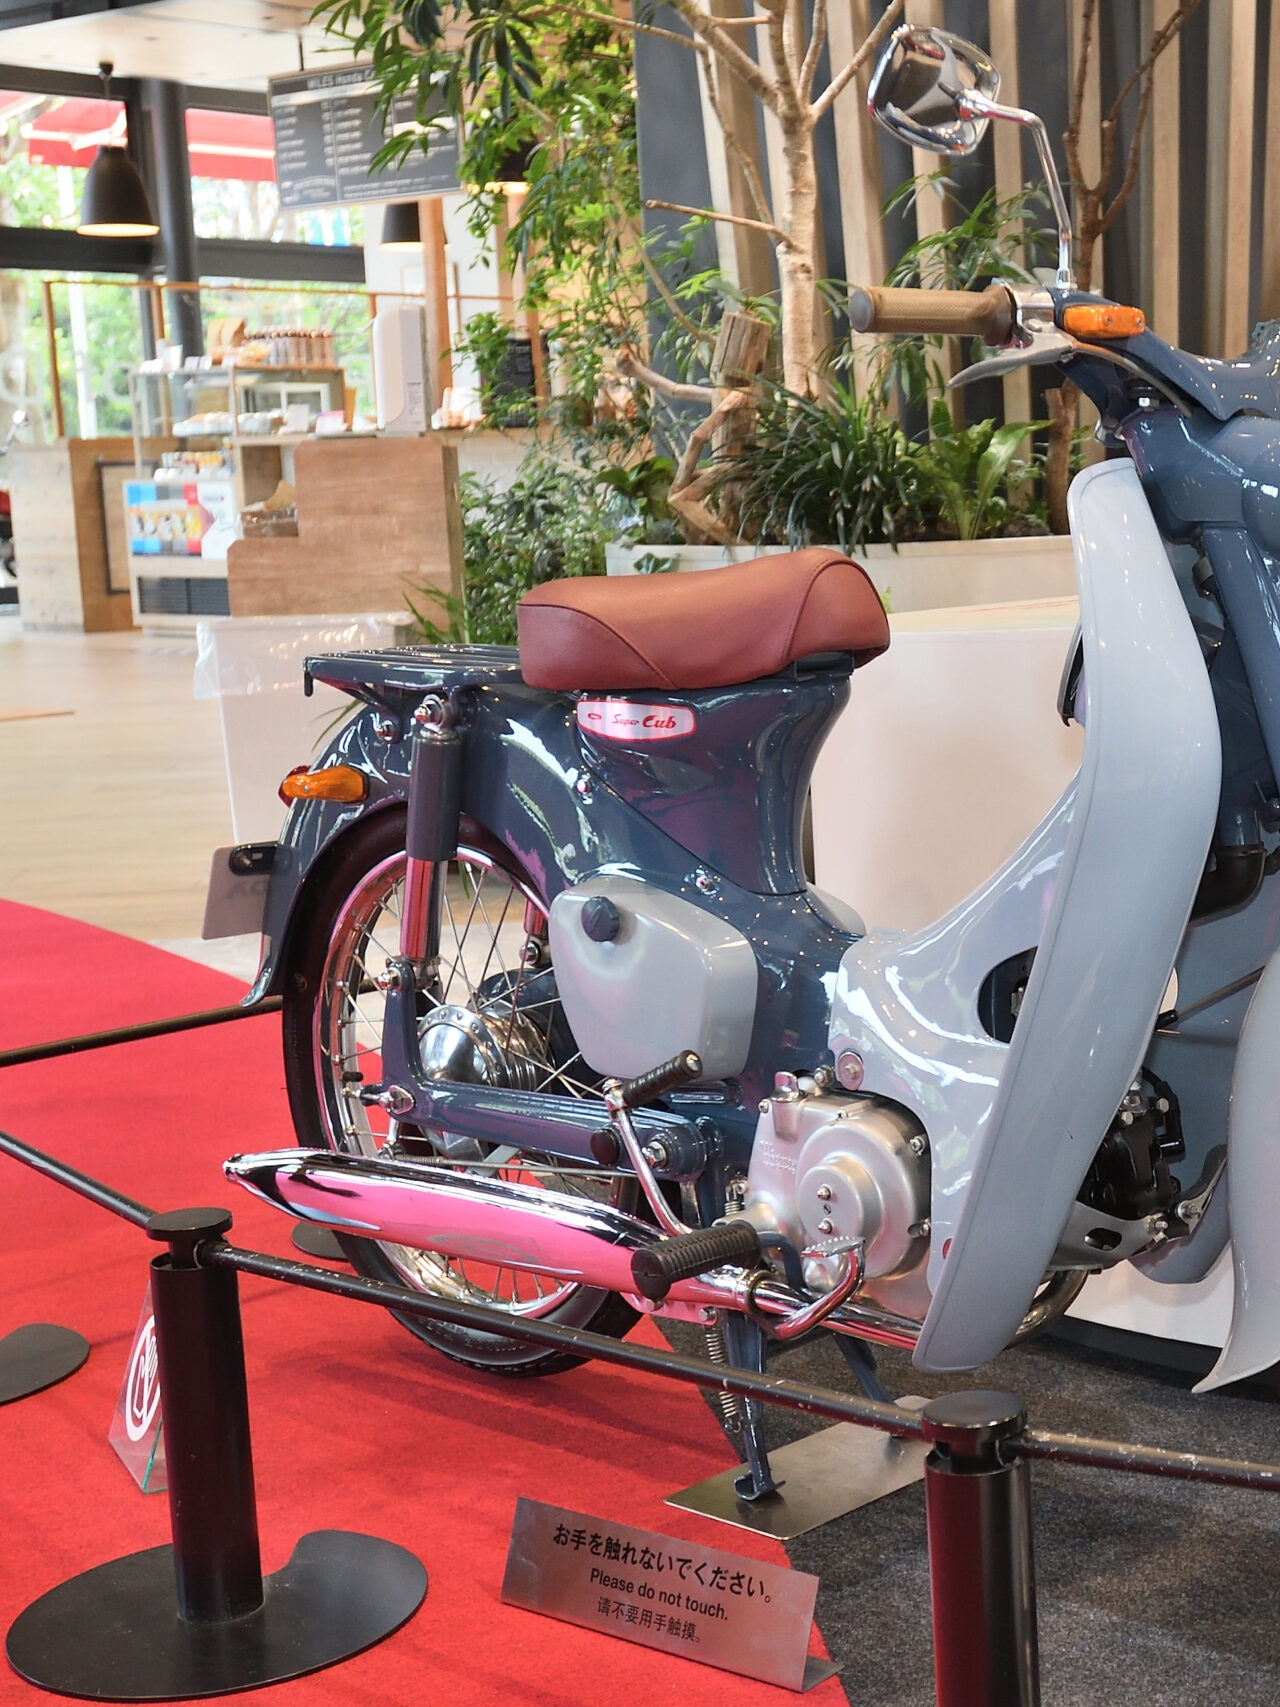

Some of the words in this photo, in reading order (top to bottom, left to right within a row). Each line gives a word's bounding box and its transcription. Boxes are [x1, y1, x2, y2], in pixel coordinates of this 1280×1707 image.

[612, 714, 640, 726] Super
[642, 715, 677, 729] Cub
[553, 1523, 774, 1605] お手を触れないでください。
[590, 1568, 635, 1595] Please
[637, 1580, 656, 1598] do
[658, 1587, 682, 1606] not
[685, 1593, 729, 1621] touch.
[597, 1597, 701, 1644] 请不要用手触摸。
